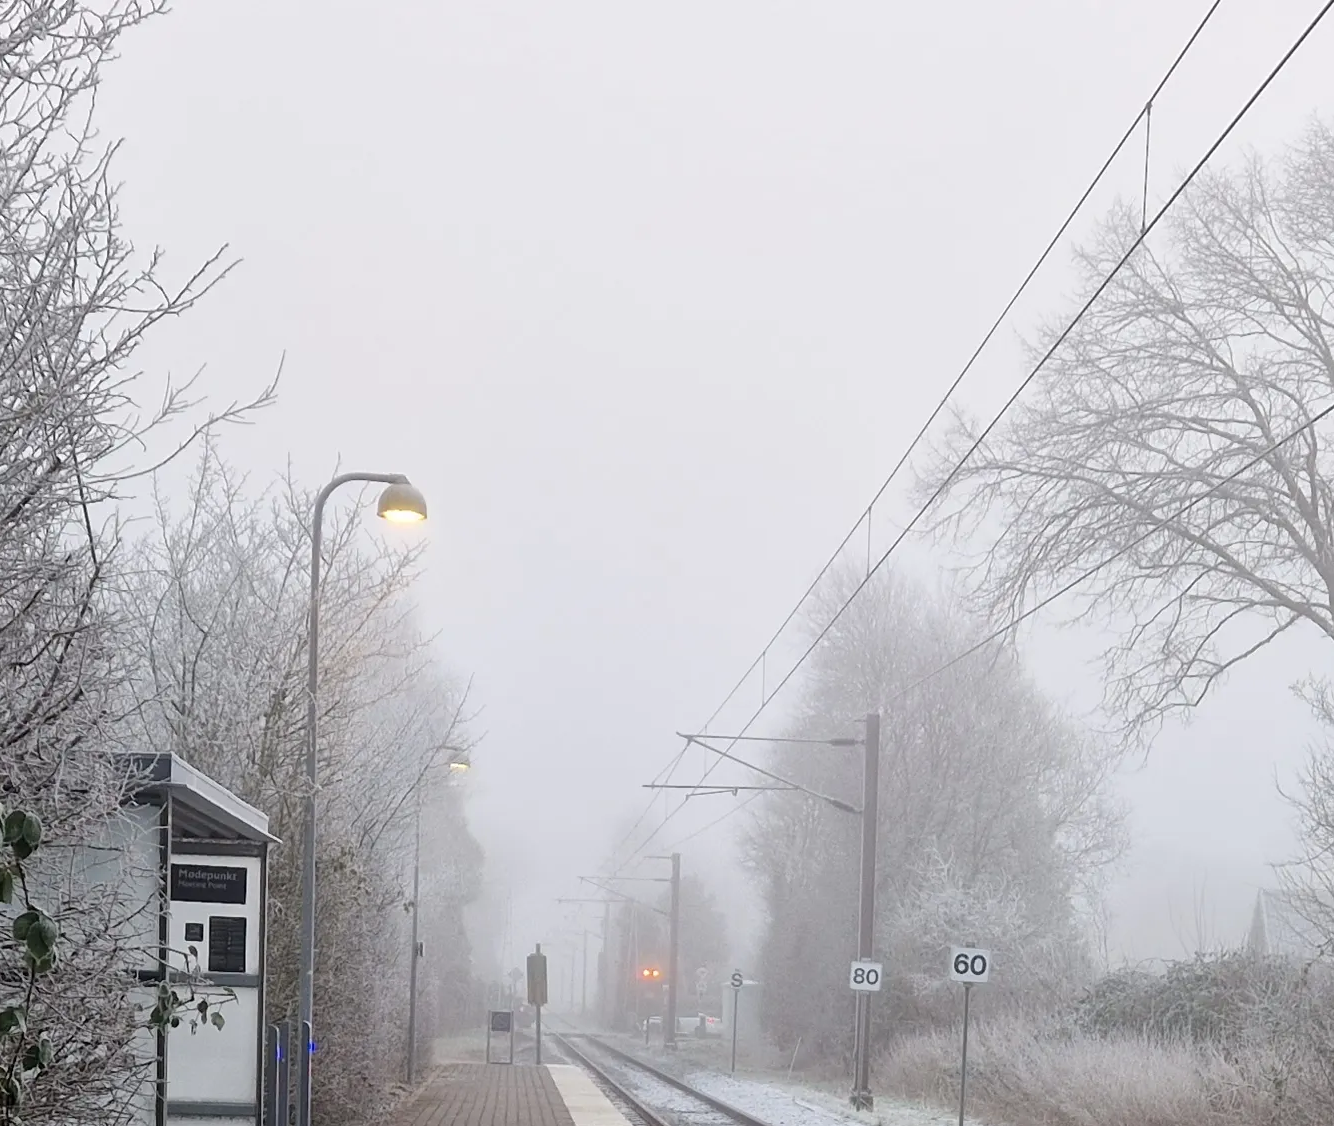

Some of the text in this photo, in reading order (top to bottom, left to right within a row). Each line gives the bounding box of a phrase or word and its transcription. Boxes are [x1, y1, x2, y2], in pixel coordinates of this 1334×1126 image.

[953, 953, 987, 976] 60
[731, 972, 744, 988] S
[852, 967, 879, 985] 80
